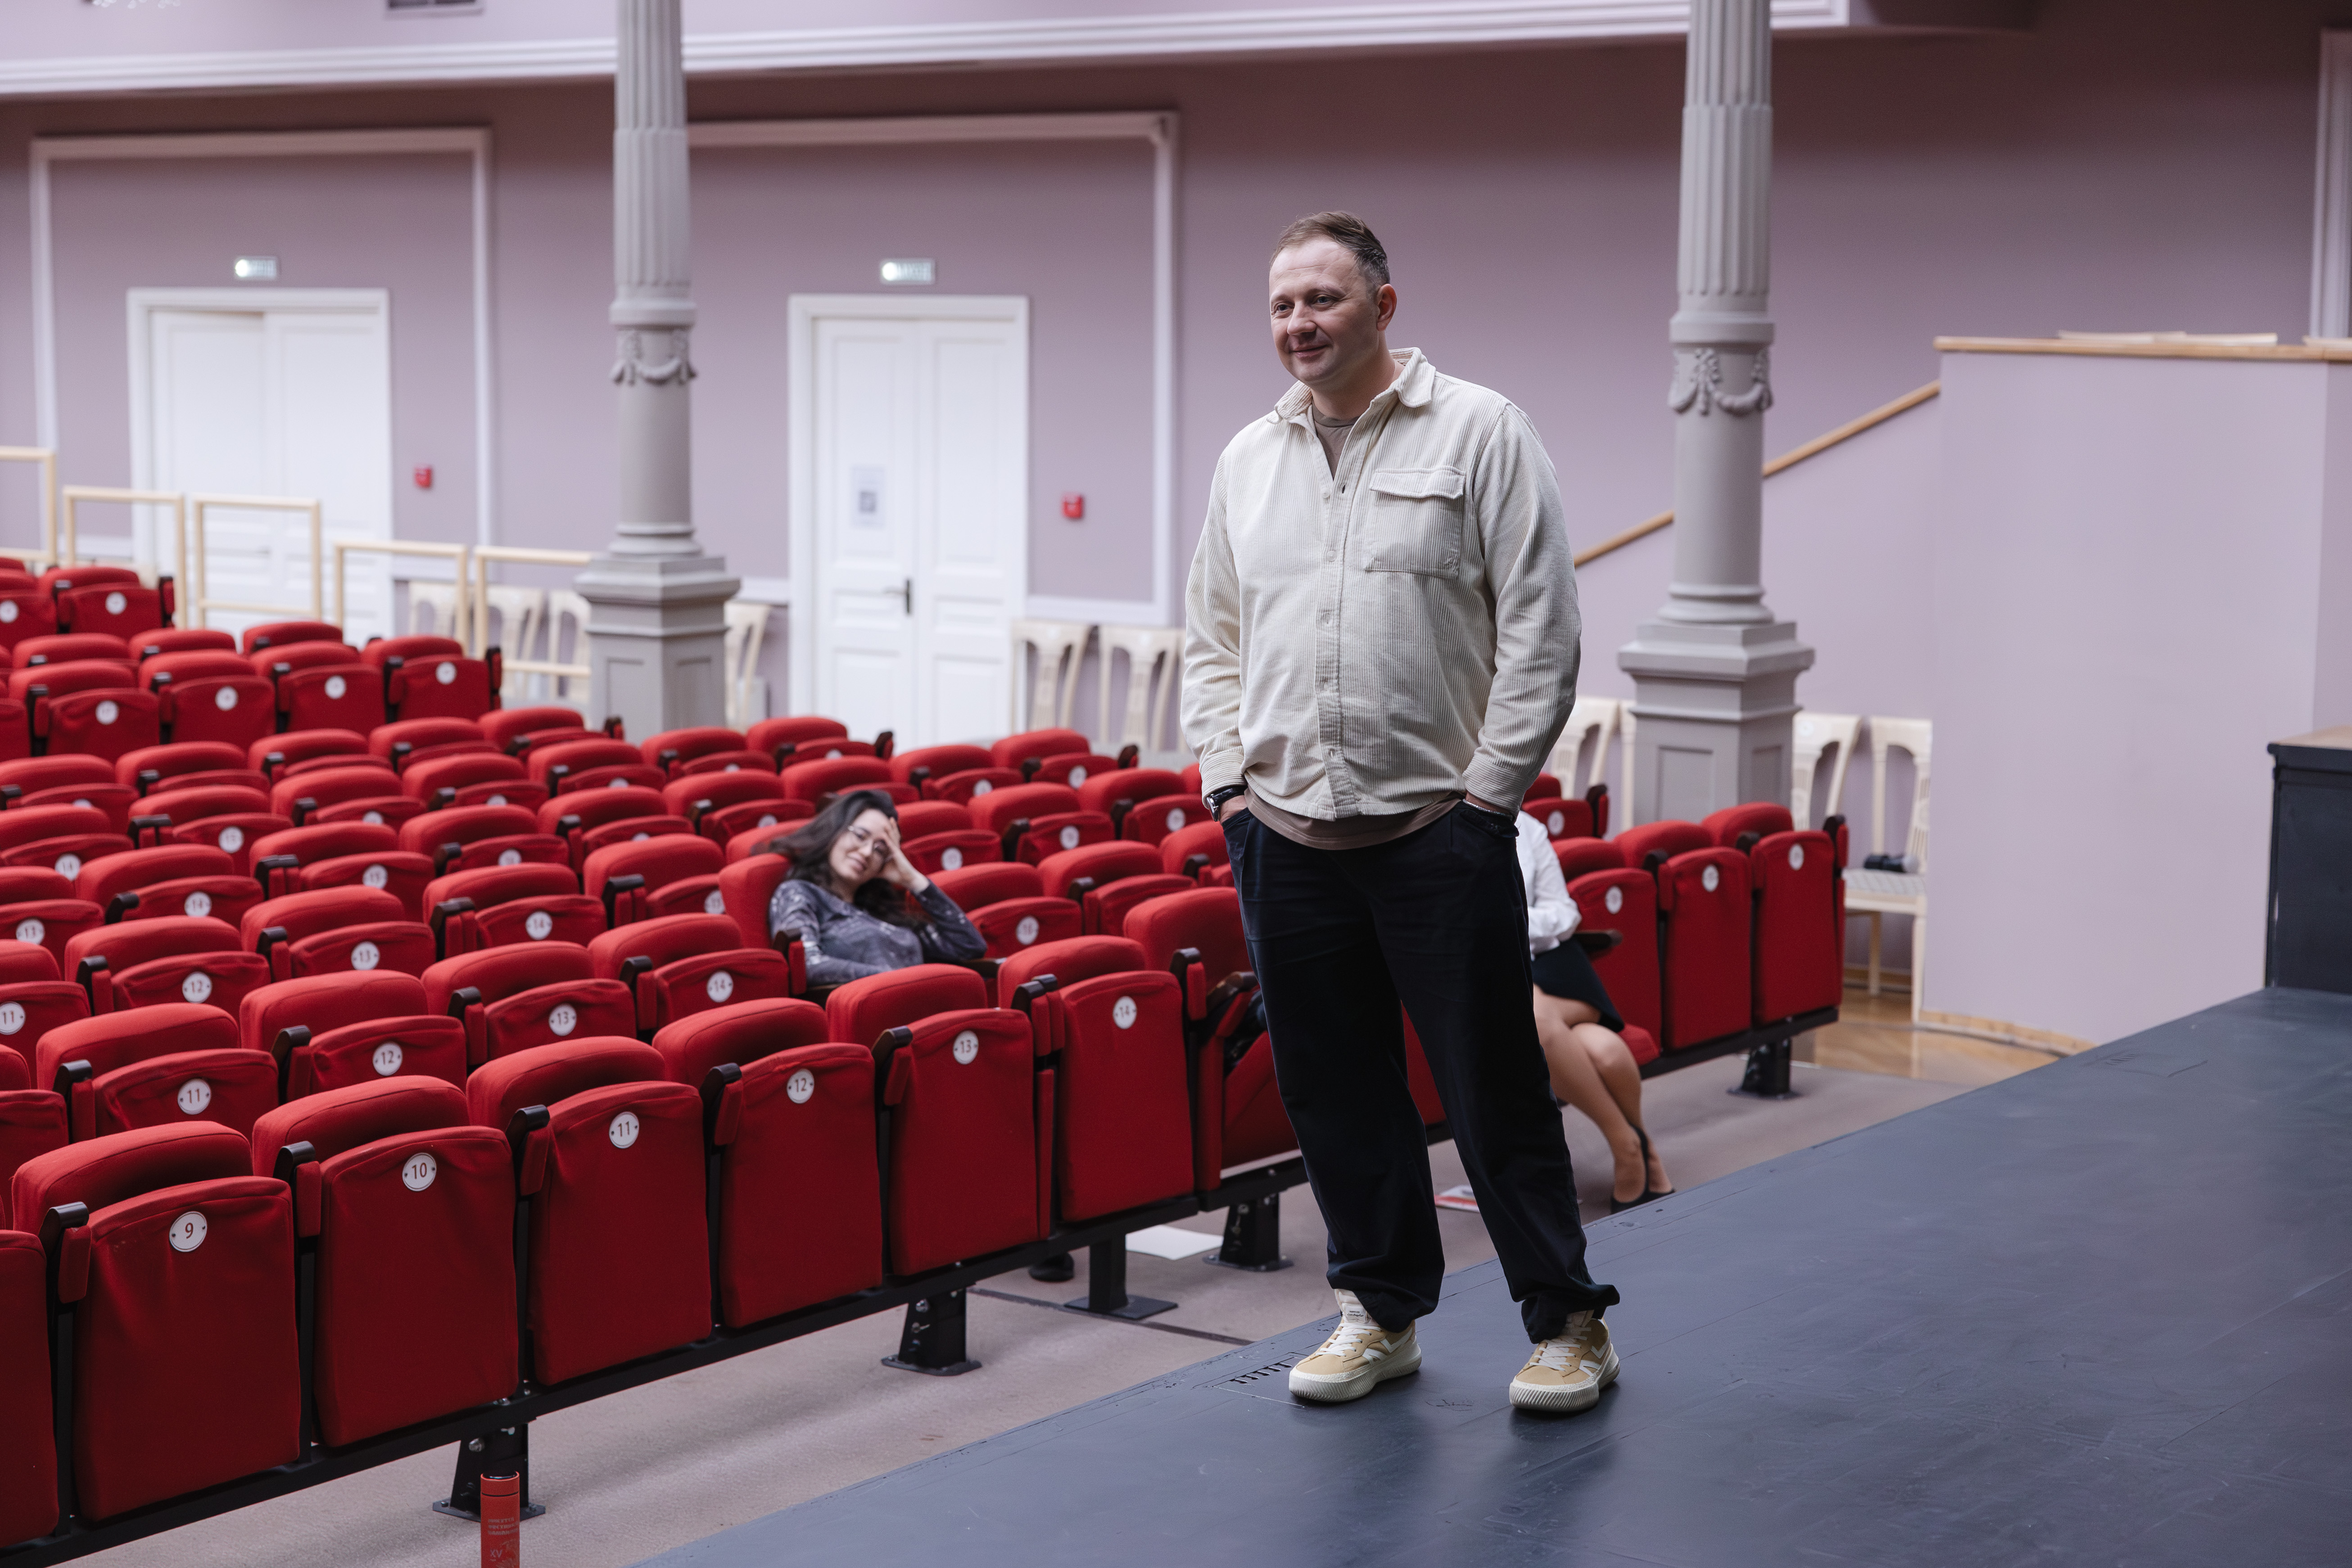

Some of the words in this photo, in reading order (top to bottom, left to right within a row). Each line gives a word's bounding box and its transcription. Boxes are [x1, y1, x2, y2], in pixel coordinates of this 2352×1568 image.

[534, 918, 544, 931] 14
[359, 949, 371, 963] 13
[191, 980, 203, 994] 12
[714, 980, 725, 993] 14
[3, 1010, 14, 1025] 11
[557, 1011, 569, 1026] 13
[1119, 1005, 1130, 1018] 14
[960, 1039, 971, 1054] 13
[382, 1050, 394, 1065] 12
[795, 1078, 806, 1093] 12
[187, 1089, 200, 1104] 11
[618, 1121, 630, 1137] 11
[412, 1162, 427, 1179] 10
[185, 1222, 194, 1239] 9
